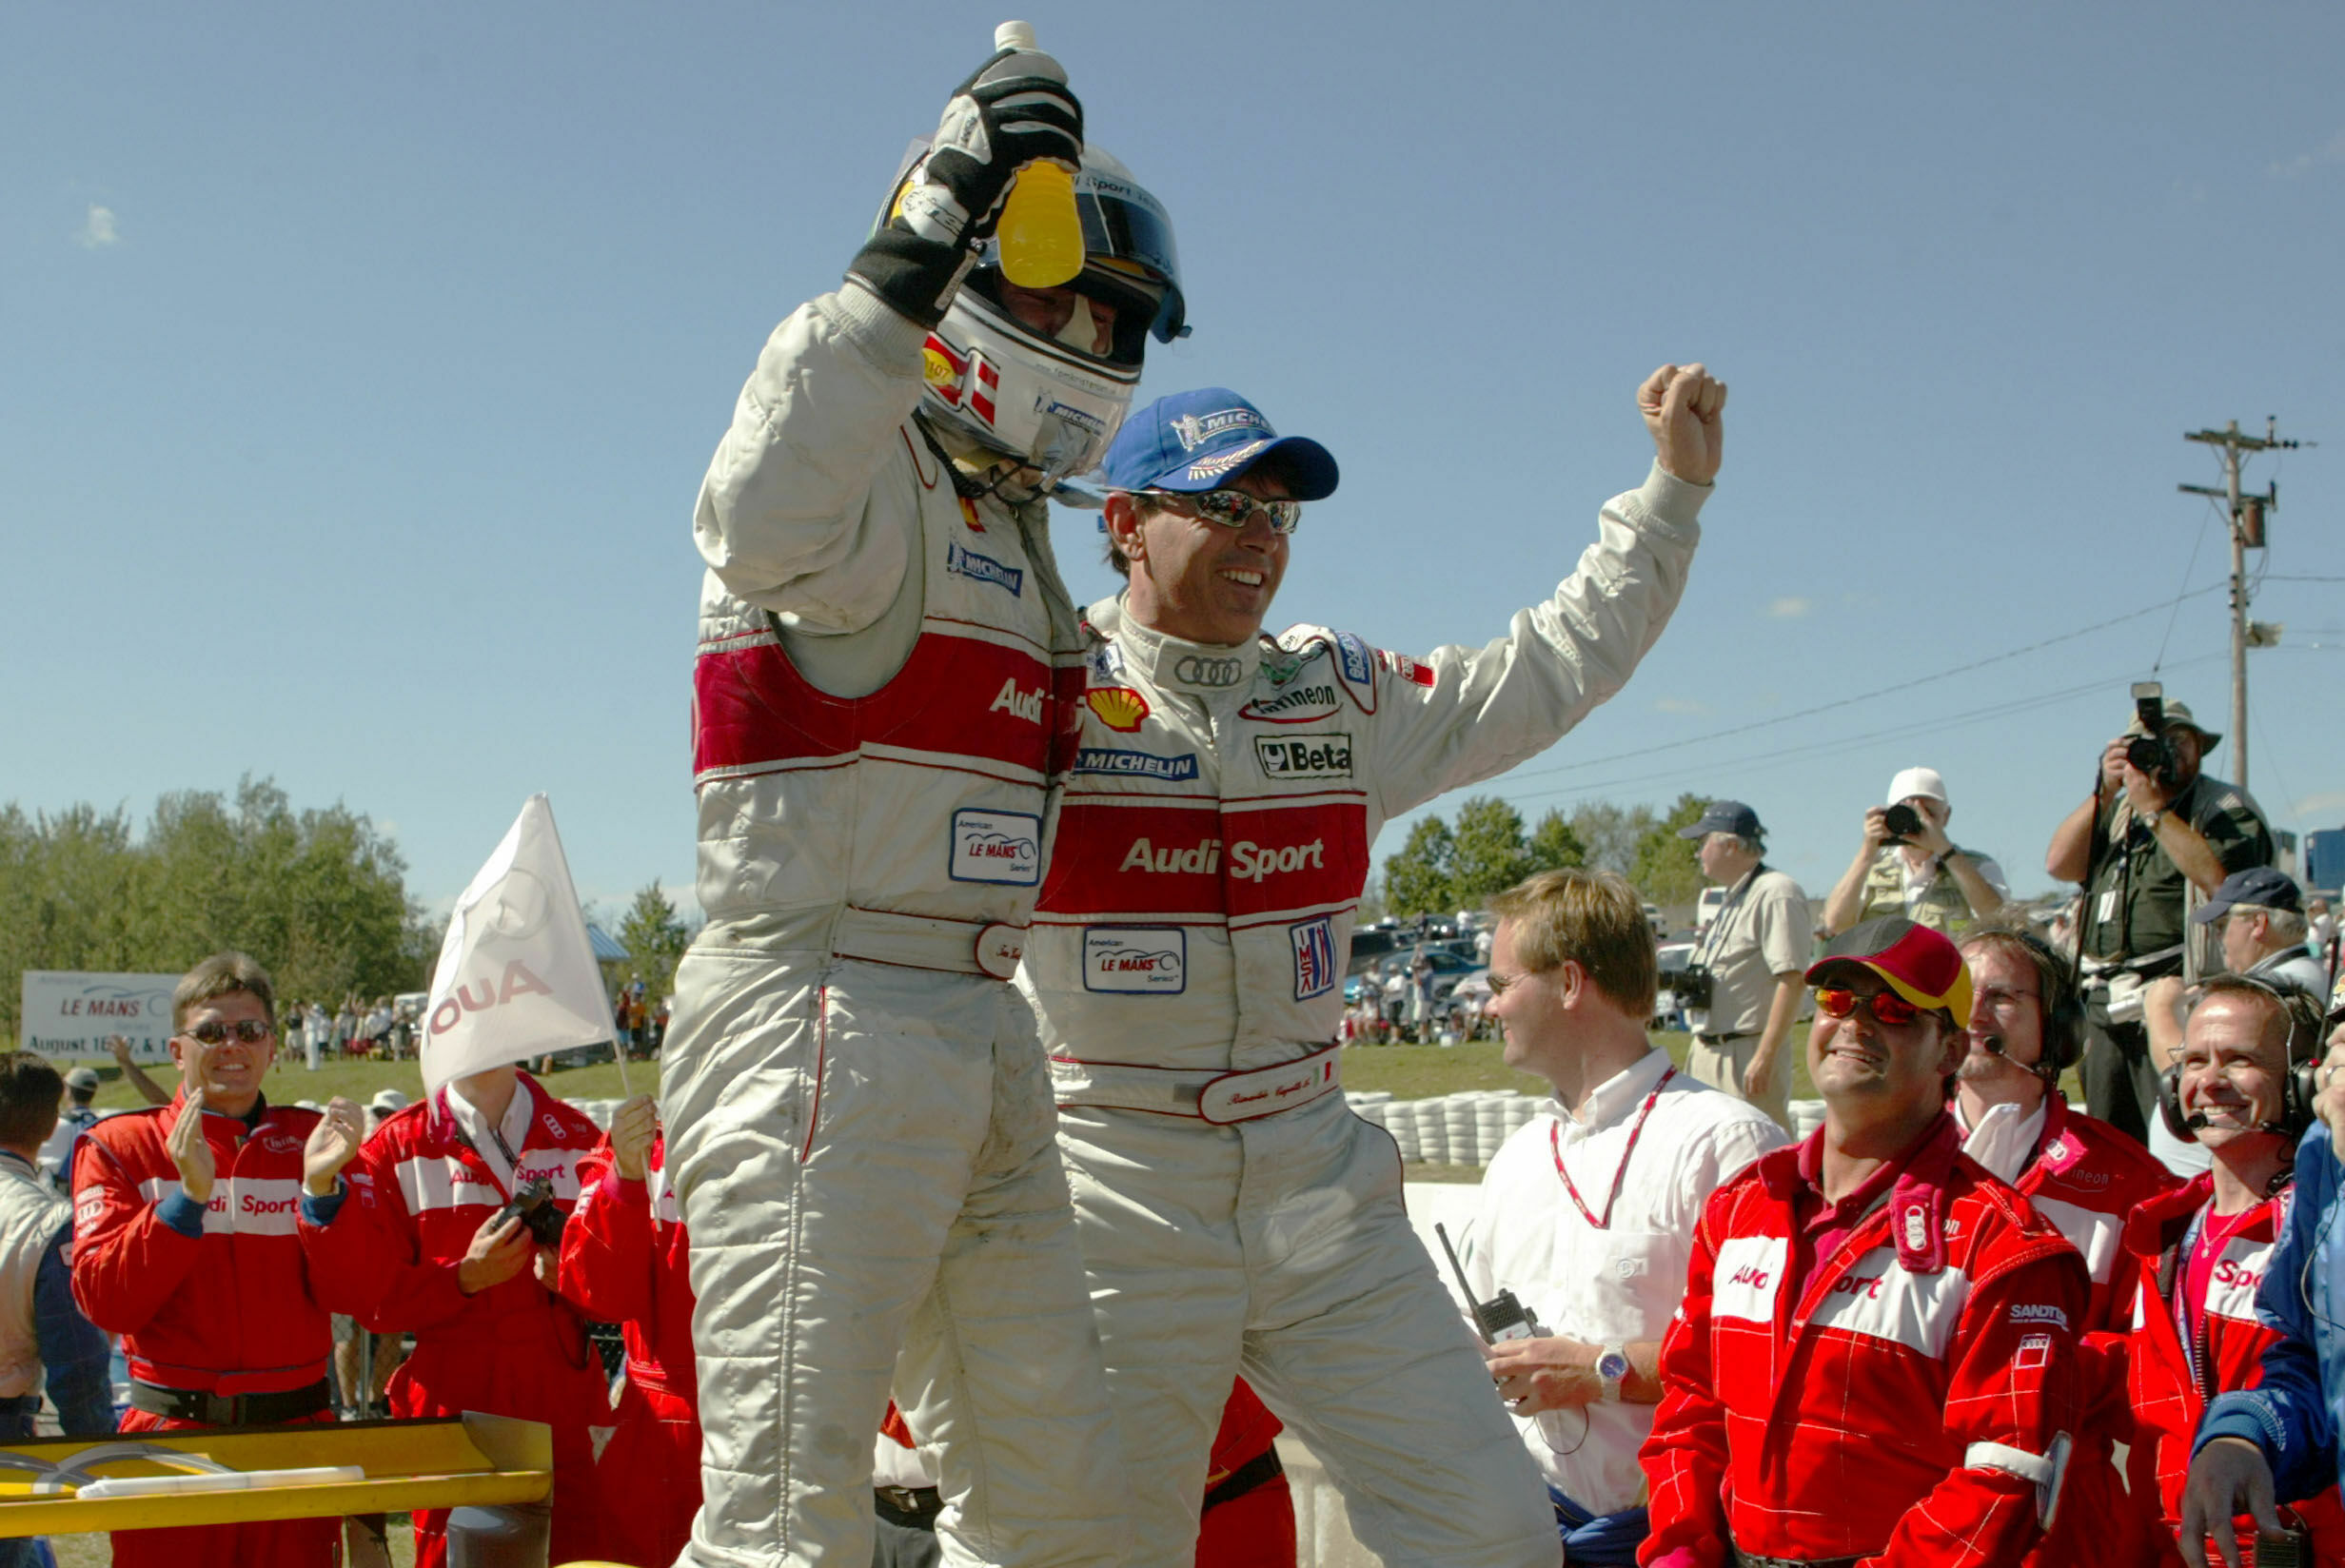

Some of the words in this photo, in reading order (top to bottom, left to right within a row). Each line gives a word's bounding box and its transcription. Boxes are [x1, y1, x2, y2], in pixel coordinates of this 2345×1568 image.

[1085, 753, 1192, 775] MICHELIN
[1291, 742, 1350, 772] Beta
[969, 843, 984, 856] LE
[986, 844, 1017, 858] MANS
[1118, 837, 1222, 874] Audi
[1230, 837, 1324, 883] Sport
[1101, 959, 1115, 971] LE
[1118, 959, 1156, 971] MANS
[1298, 929, 1312, 994] IMSA
[61, 1000, 82, 1016] LE
[87, 1000, 141, 1017] MANS
[30, 1035, 87, 1053] August
[240, 1195, 298, 1216] Sport
